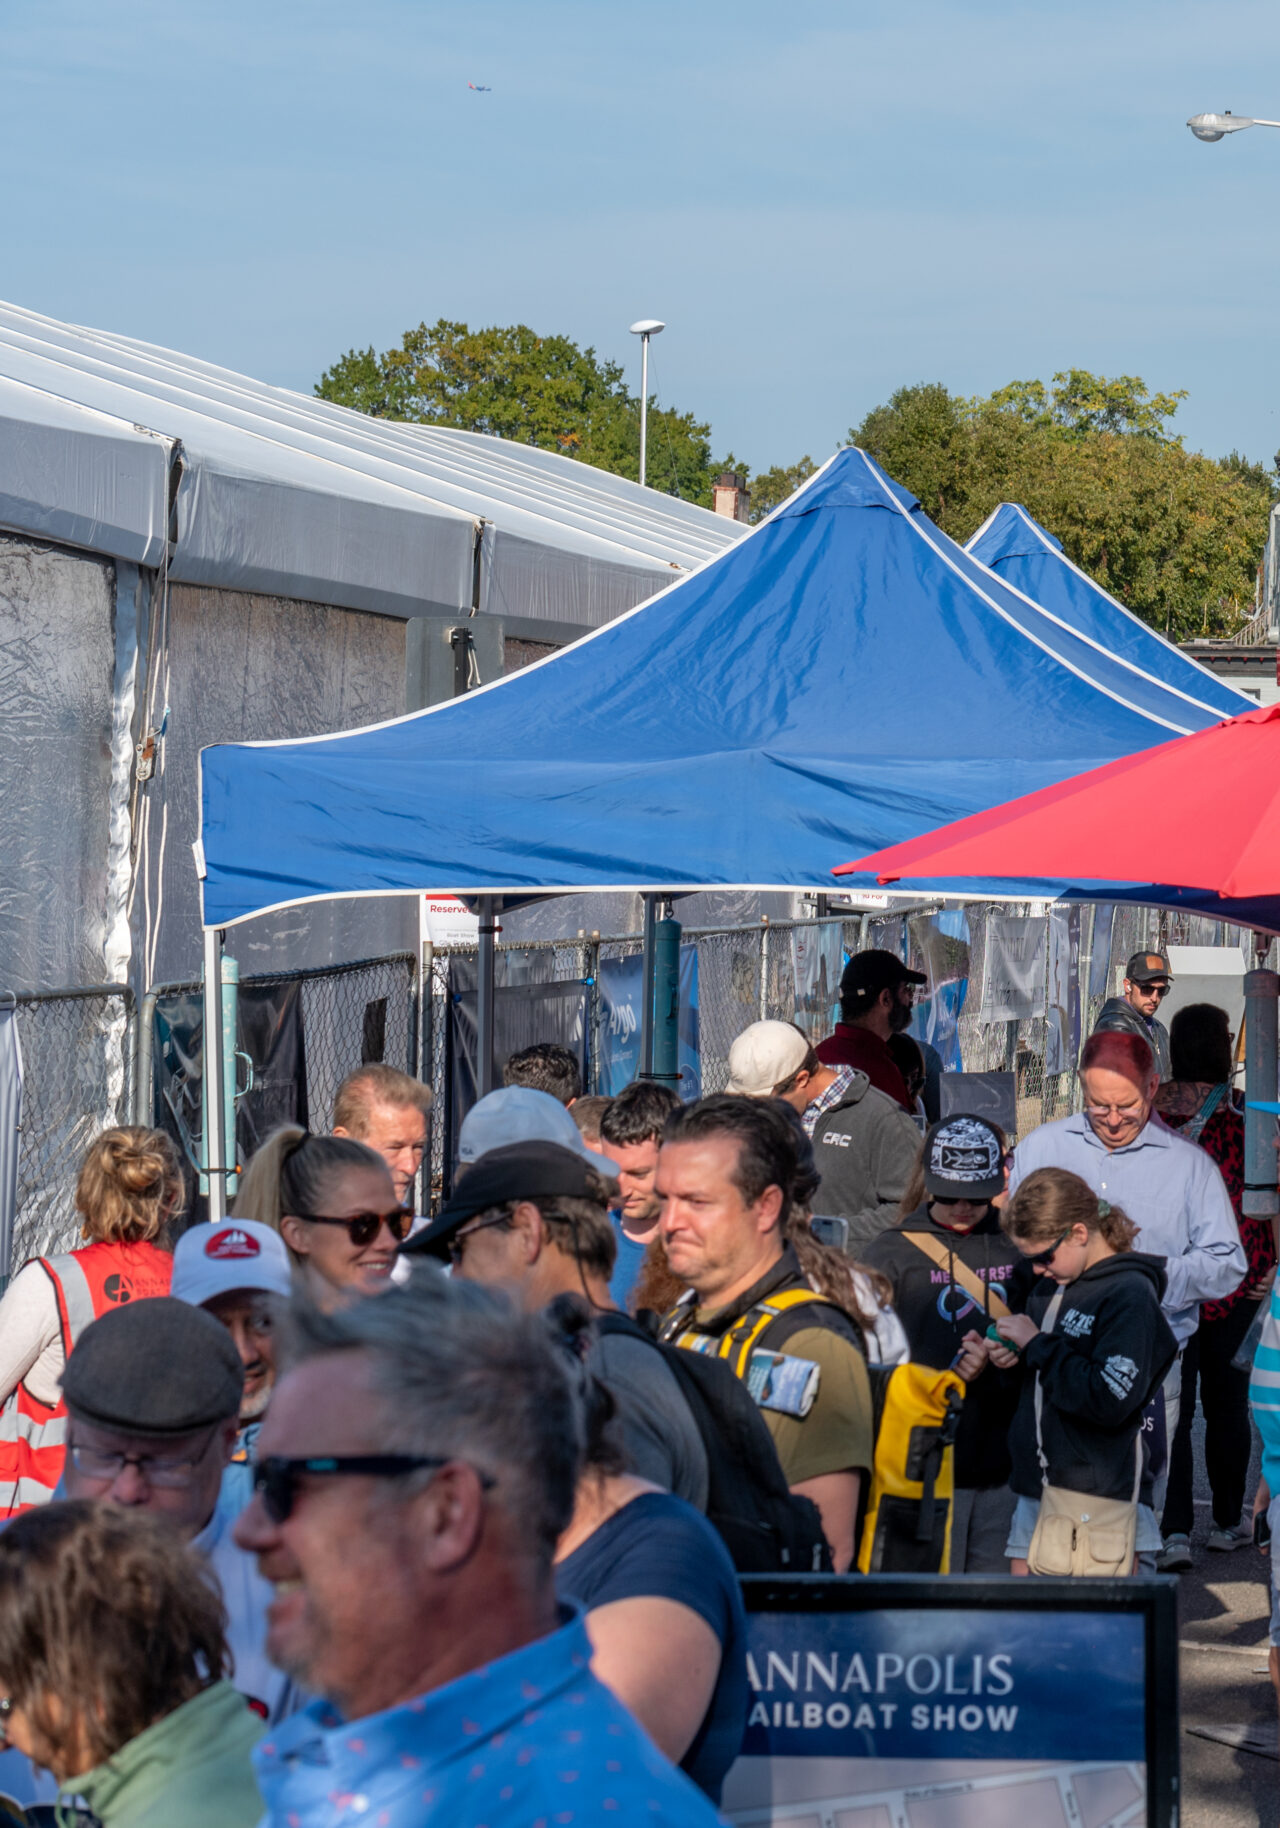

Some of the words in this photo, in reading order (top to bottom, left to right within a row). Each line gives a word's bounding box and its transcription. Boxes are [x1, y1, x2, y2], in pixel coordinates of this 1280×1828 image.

[430, 904, 470, 914] Reserve
[822, 1131, 852, 1147] CRC
[931, 1265, 1014, 1284] MEERSE
[748, 1702, 897, 1730] AILBOAT
[911, 1704, 1018, 1732] SHOW
